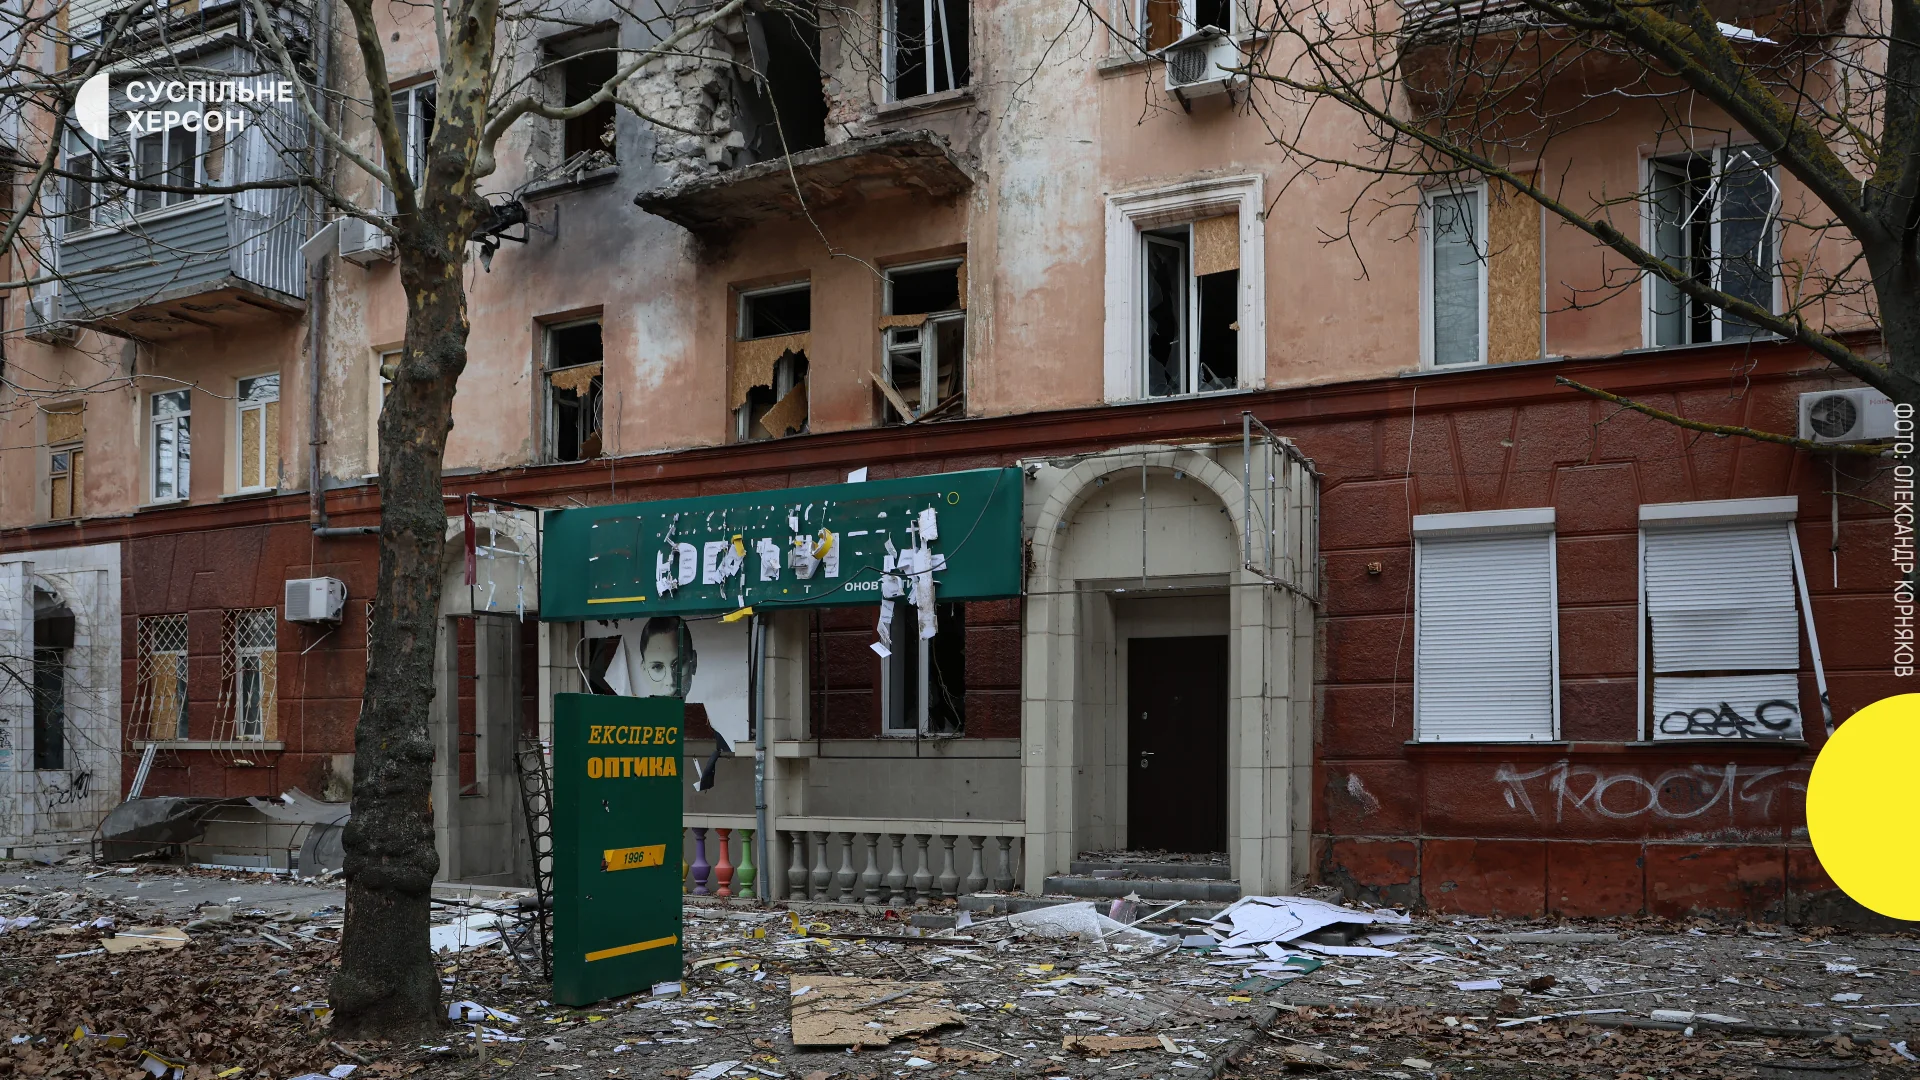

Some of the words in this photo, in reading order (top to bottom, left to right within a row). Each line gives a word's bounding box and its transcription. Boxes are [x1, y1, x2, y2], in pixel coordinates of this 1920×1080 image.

[588, 725, 678, 745] ЕКСПРЕС
[587, 757, 678, 779] ОПТИКА
[624, 851, 645, 864] 1996
